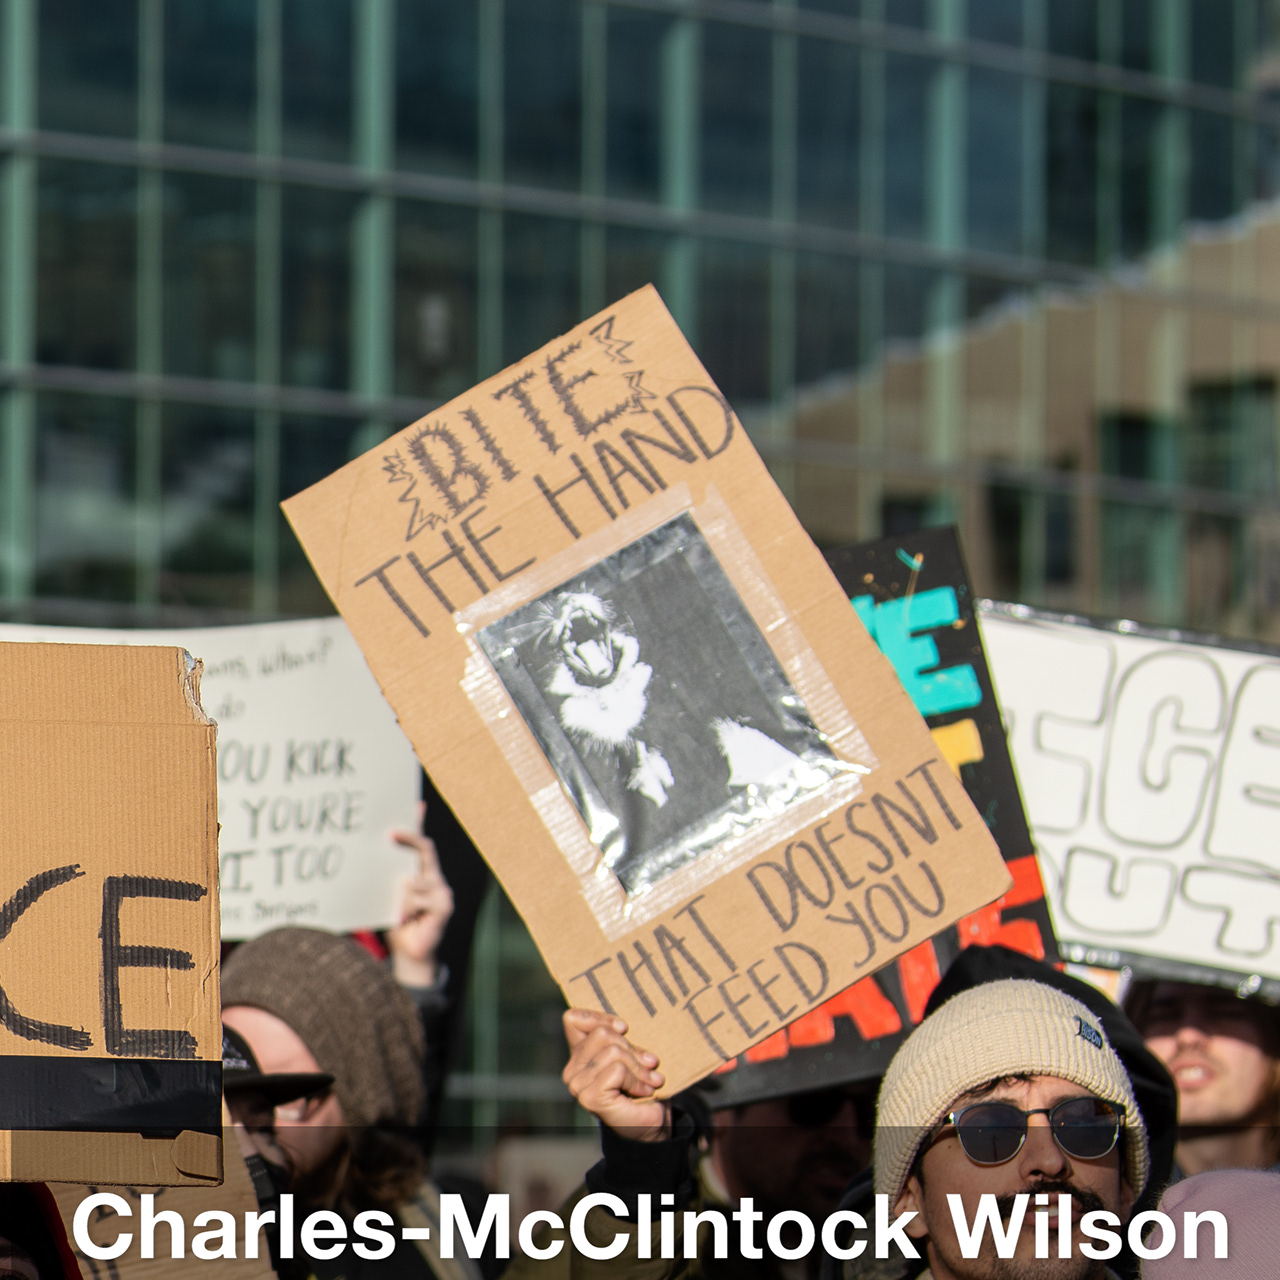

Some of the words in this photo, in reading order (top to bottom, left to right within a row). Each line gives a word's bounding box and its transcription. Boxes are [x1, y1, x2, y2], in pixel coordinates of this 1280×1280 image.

[354, 504, 537, 639] THE
[533, 384, 736, 541] HAND
[402, 338, 638, 520] BITE
[219, 739, 271, 785] OU
[284, 739, 358, 783] KICK
[569, 895, 739, 1021] THAT
[745, 757, 966, 934] DOESNT
[681, 942, 830, 1061] FEED
[824, 859, 949, 969] YOU
